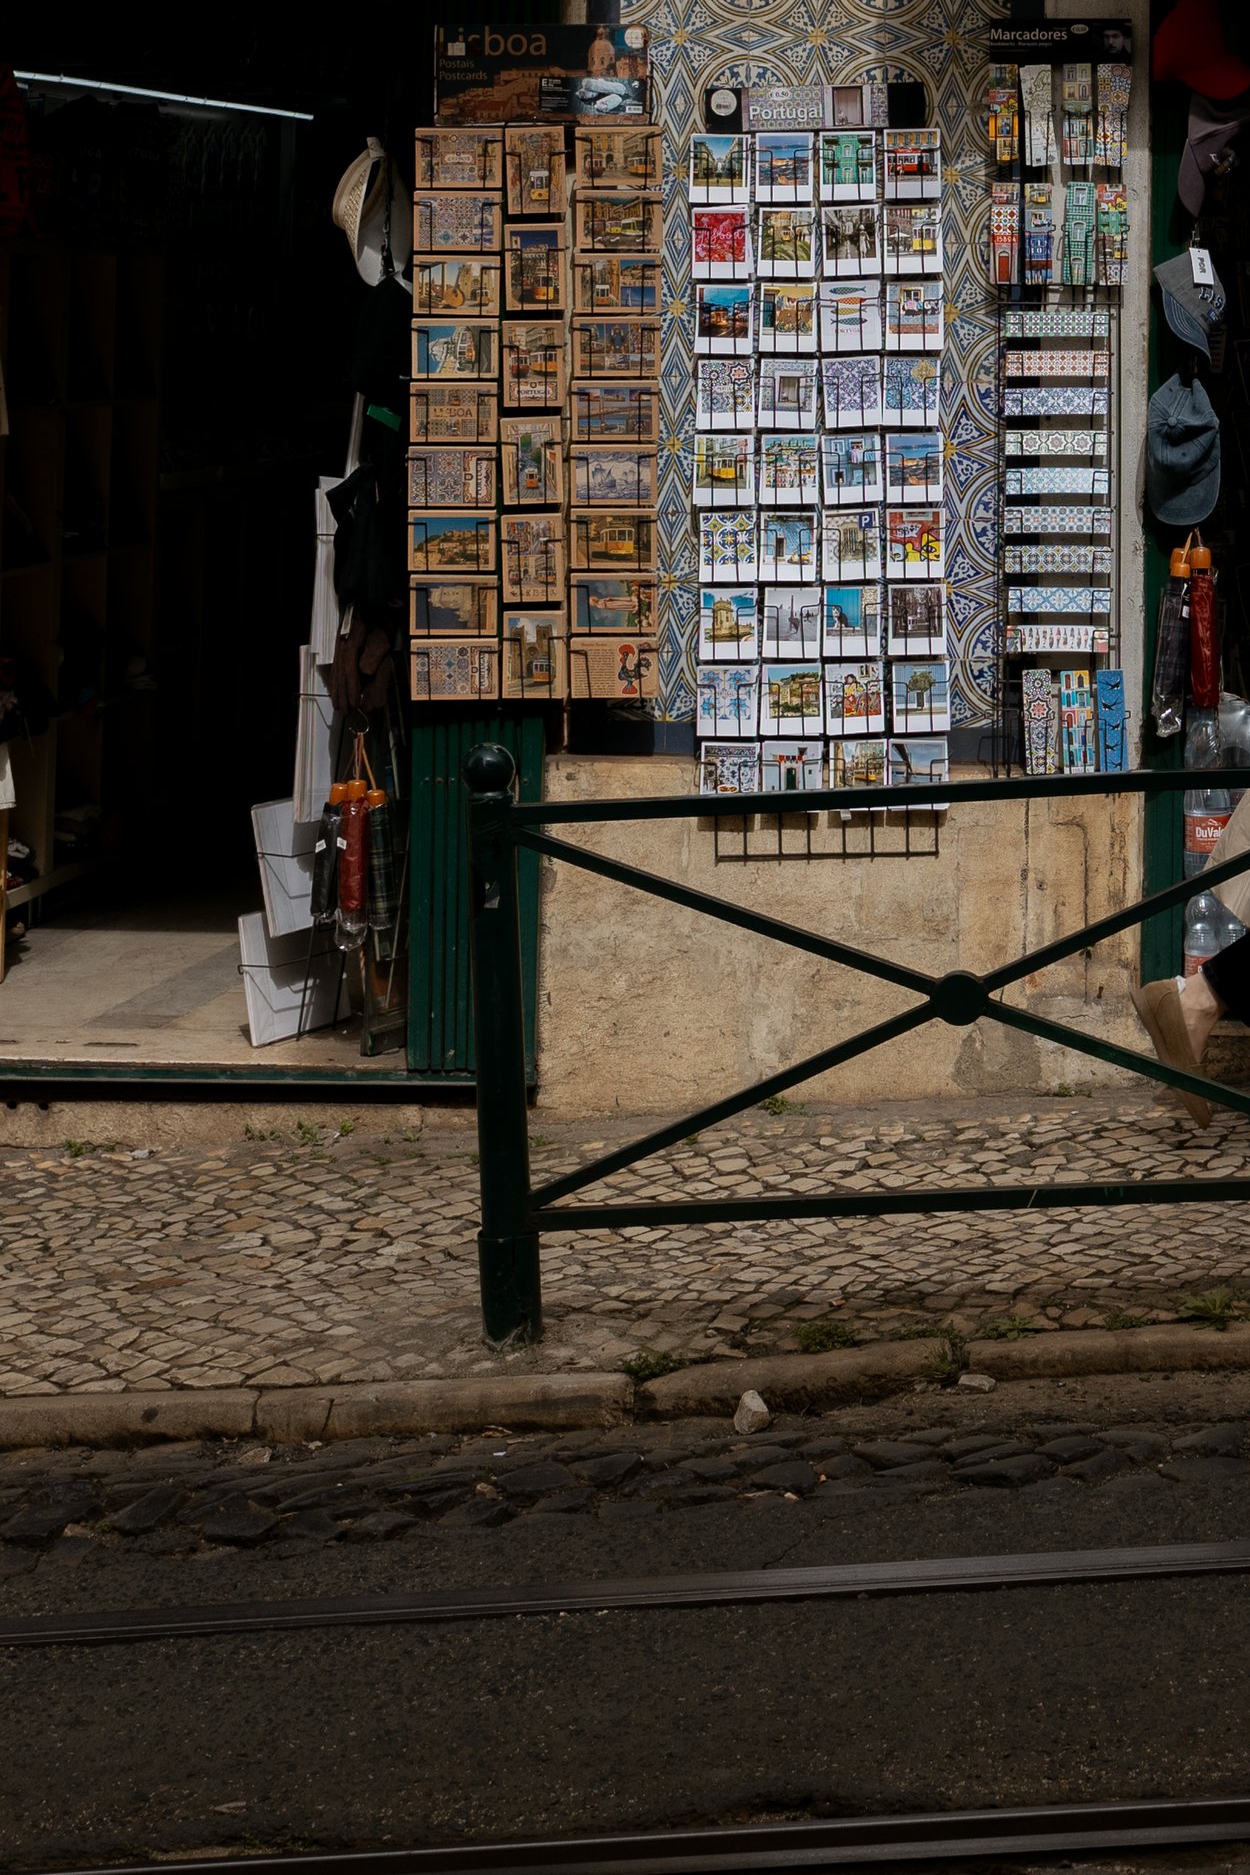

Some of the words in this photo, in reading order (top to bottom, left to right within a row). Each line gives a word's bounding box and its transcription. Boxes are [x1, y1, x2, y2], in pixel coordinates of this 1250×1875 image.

[990, 27, 1068, 41] Marcadores
[440, 59, 475, 69] Postais
[440, 70, 488, 81] Postcards
[749, 104, 823, 122] Portugal
[861, 515, 870, 526] P
